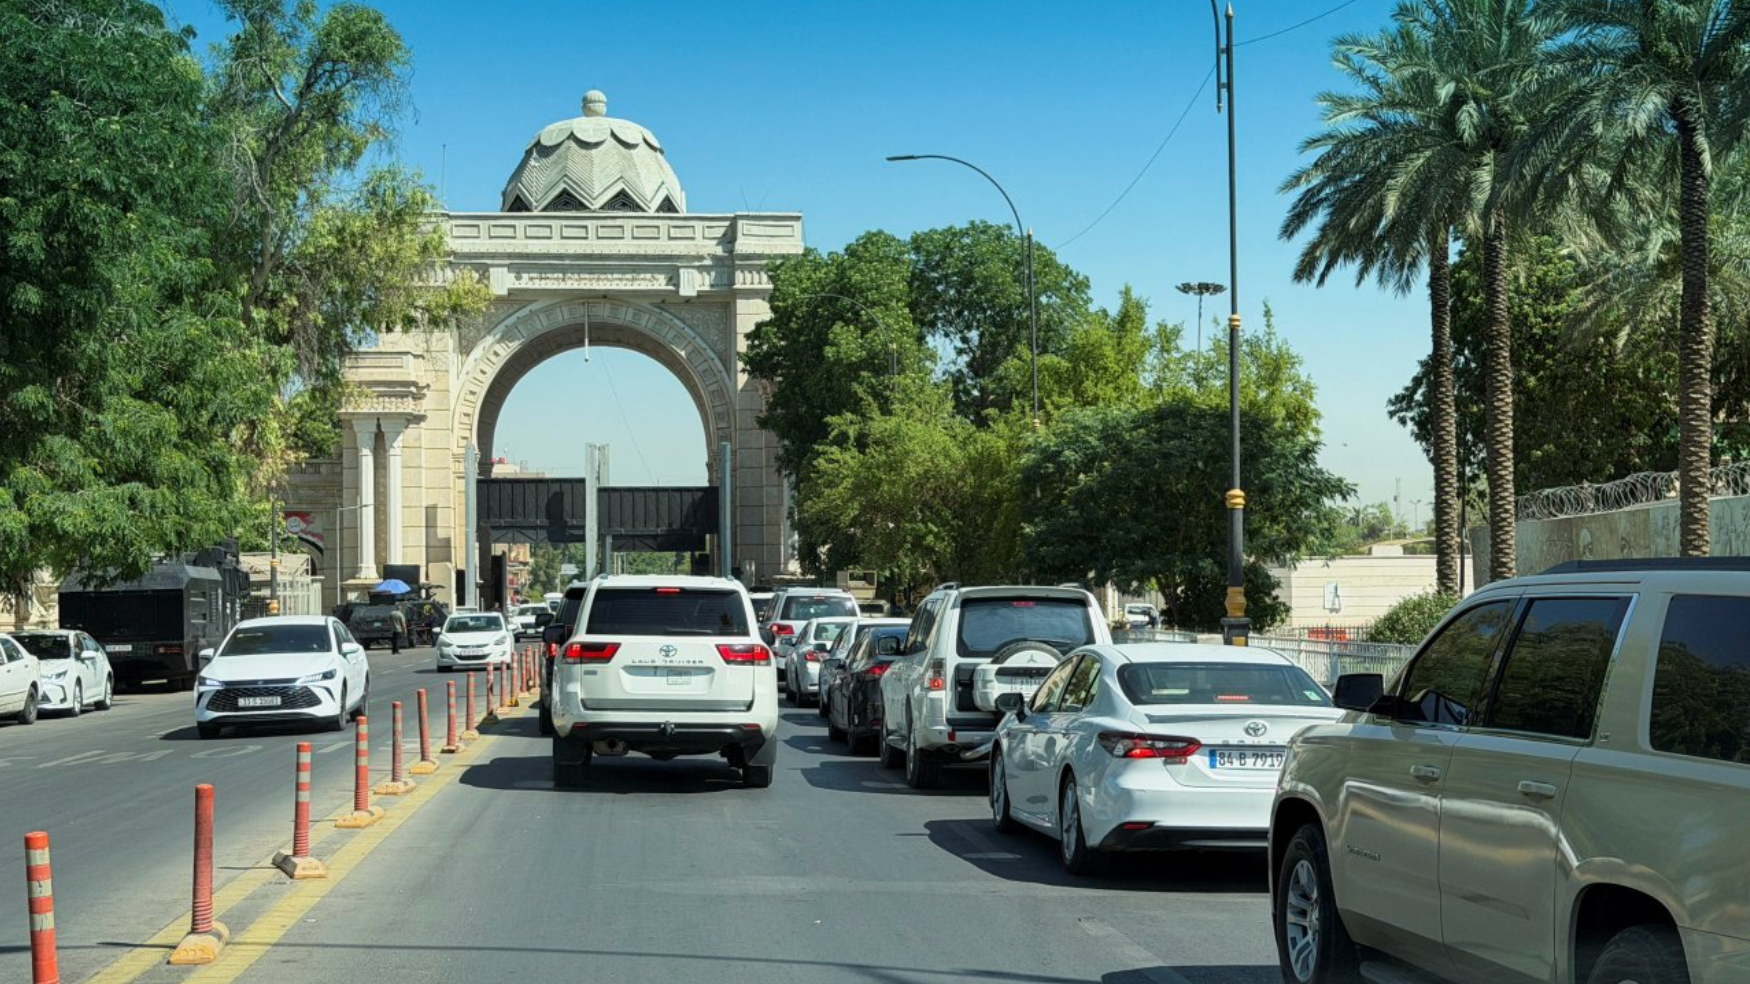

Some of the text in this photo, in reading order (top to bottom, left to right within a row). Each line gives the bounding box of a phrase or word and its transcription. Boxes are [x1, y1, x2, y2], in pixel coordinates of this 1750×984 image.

[1218, 752, 1283, 767] 84 B 7919
